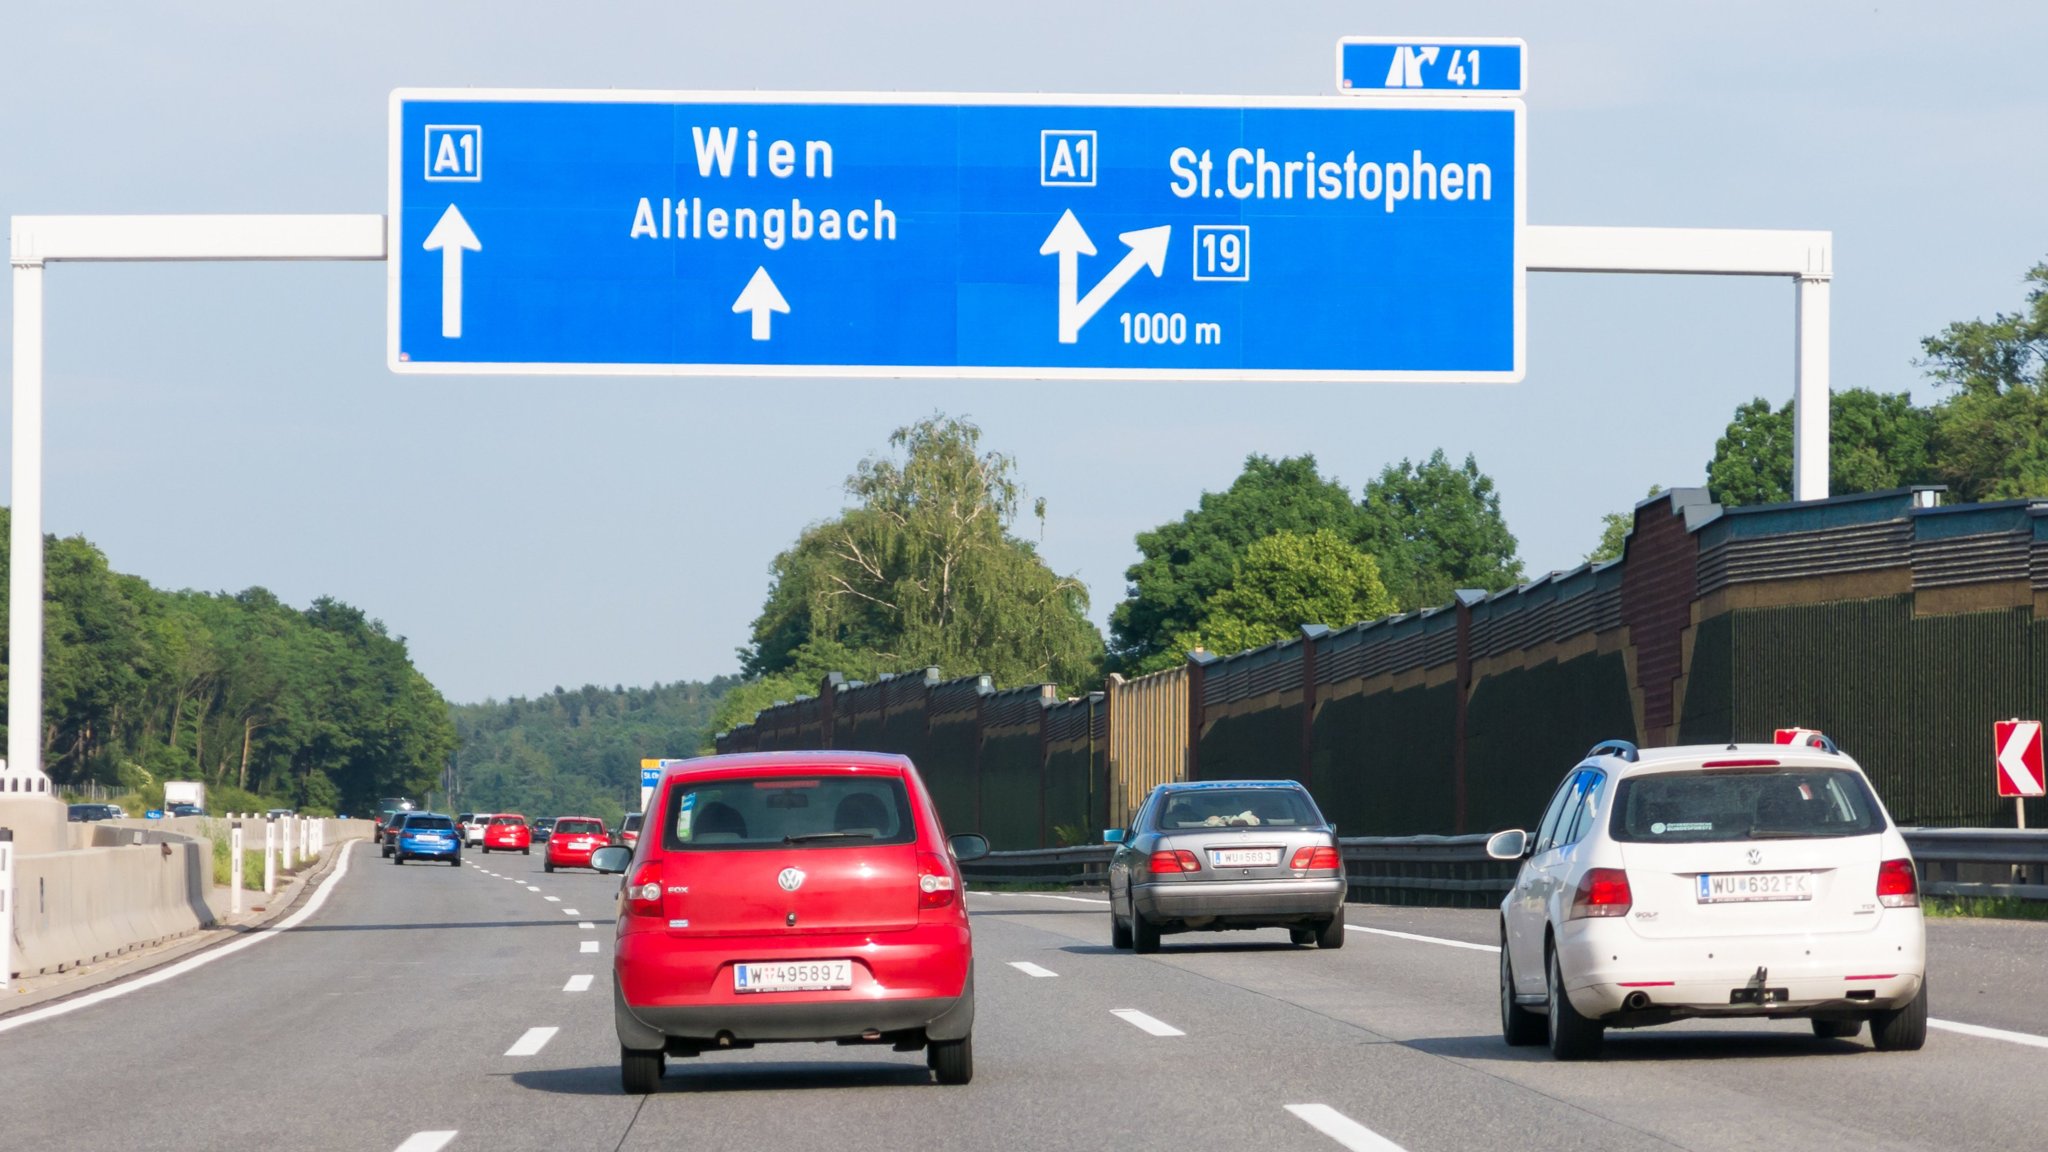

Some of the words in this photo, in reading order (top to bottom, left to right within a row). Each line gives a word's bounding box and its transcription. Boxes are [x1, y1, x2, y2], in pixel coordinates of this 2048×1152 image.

[1447, 49, 1480, 86] 41
[433, 133, 474, 174] A1
[691, 126, 833, 179] Wien
[1050, 138, 1089, 178] A1
[1169, 146, 1492, 213] St.Christophen
[630, 197, 896, 250] Altlengbach
[1202, 233, 1241, 273] 19
[1120, 312, 1187, 345] 1000
[1195, 321, 1221, 345] m
[1712, 877, 1736, 894] WU
[1749, 875, 1781, 893] 632
[1784, 874, 1806, 892] FK
[750, 967, 763, 984] W
[777, 965, 831, 983] 49589
[834, 965, 845, 981] Z
